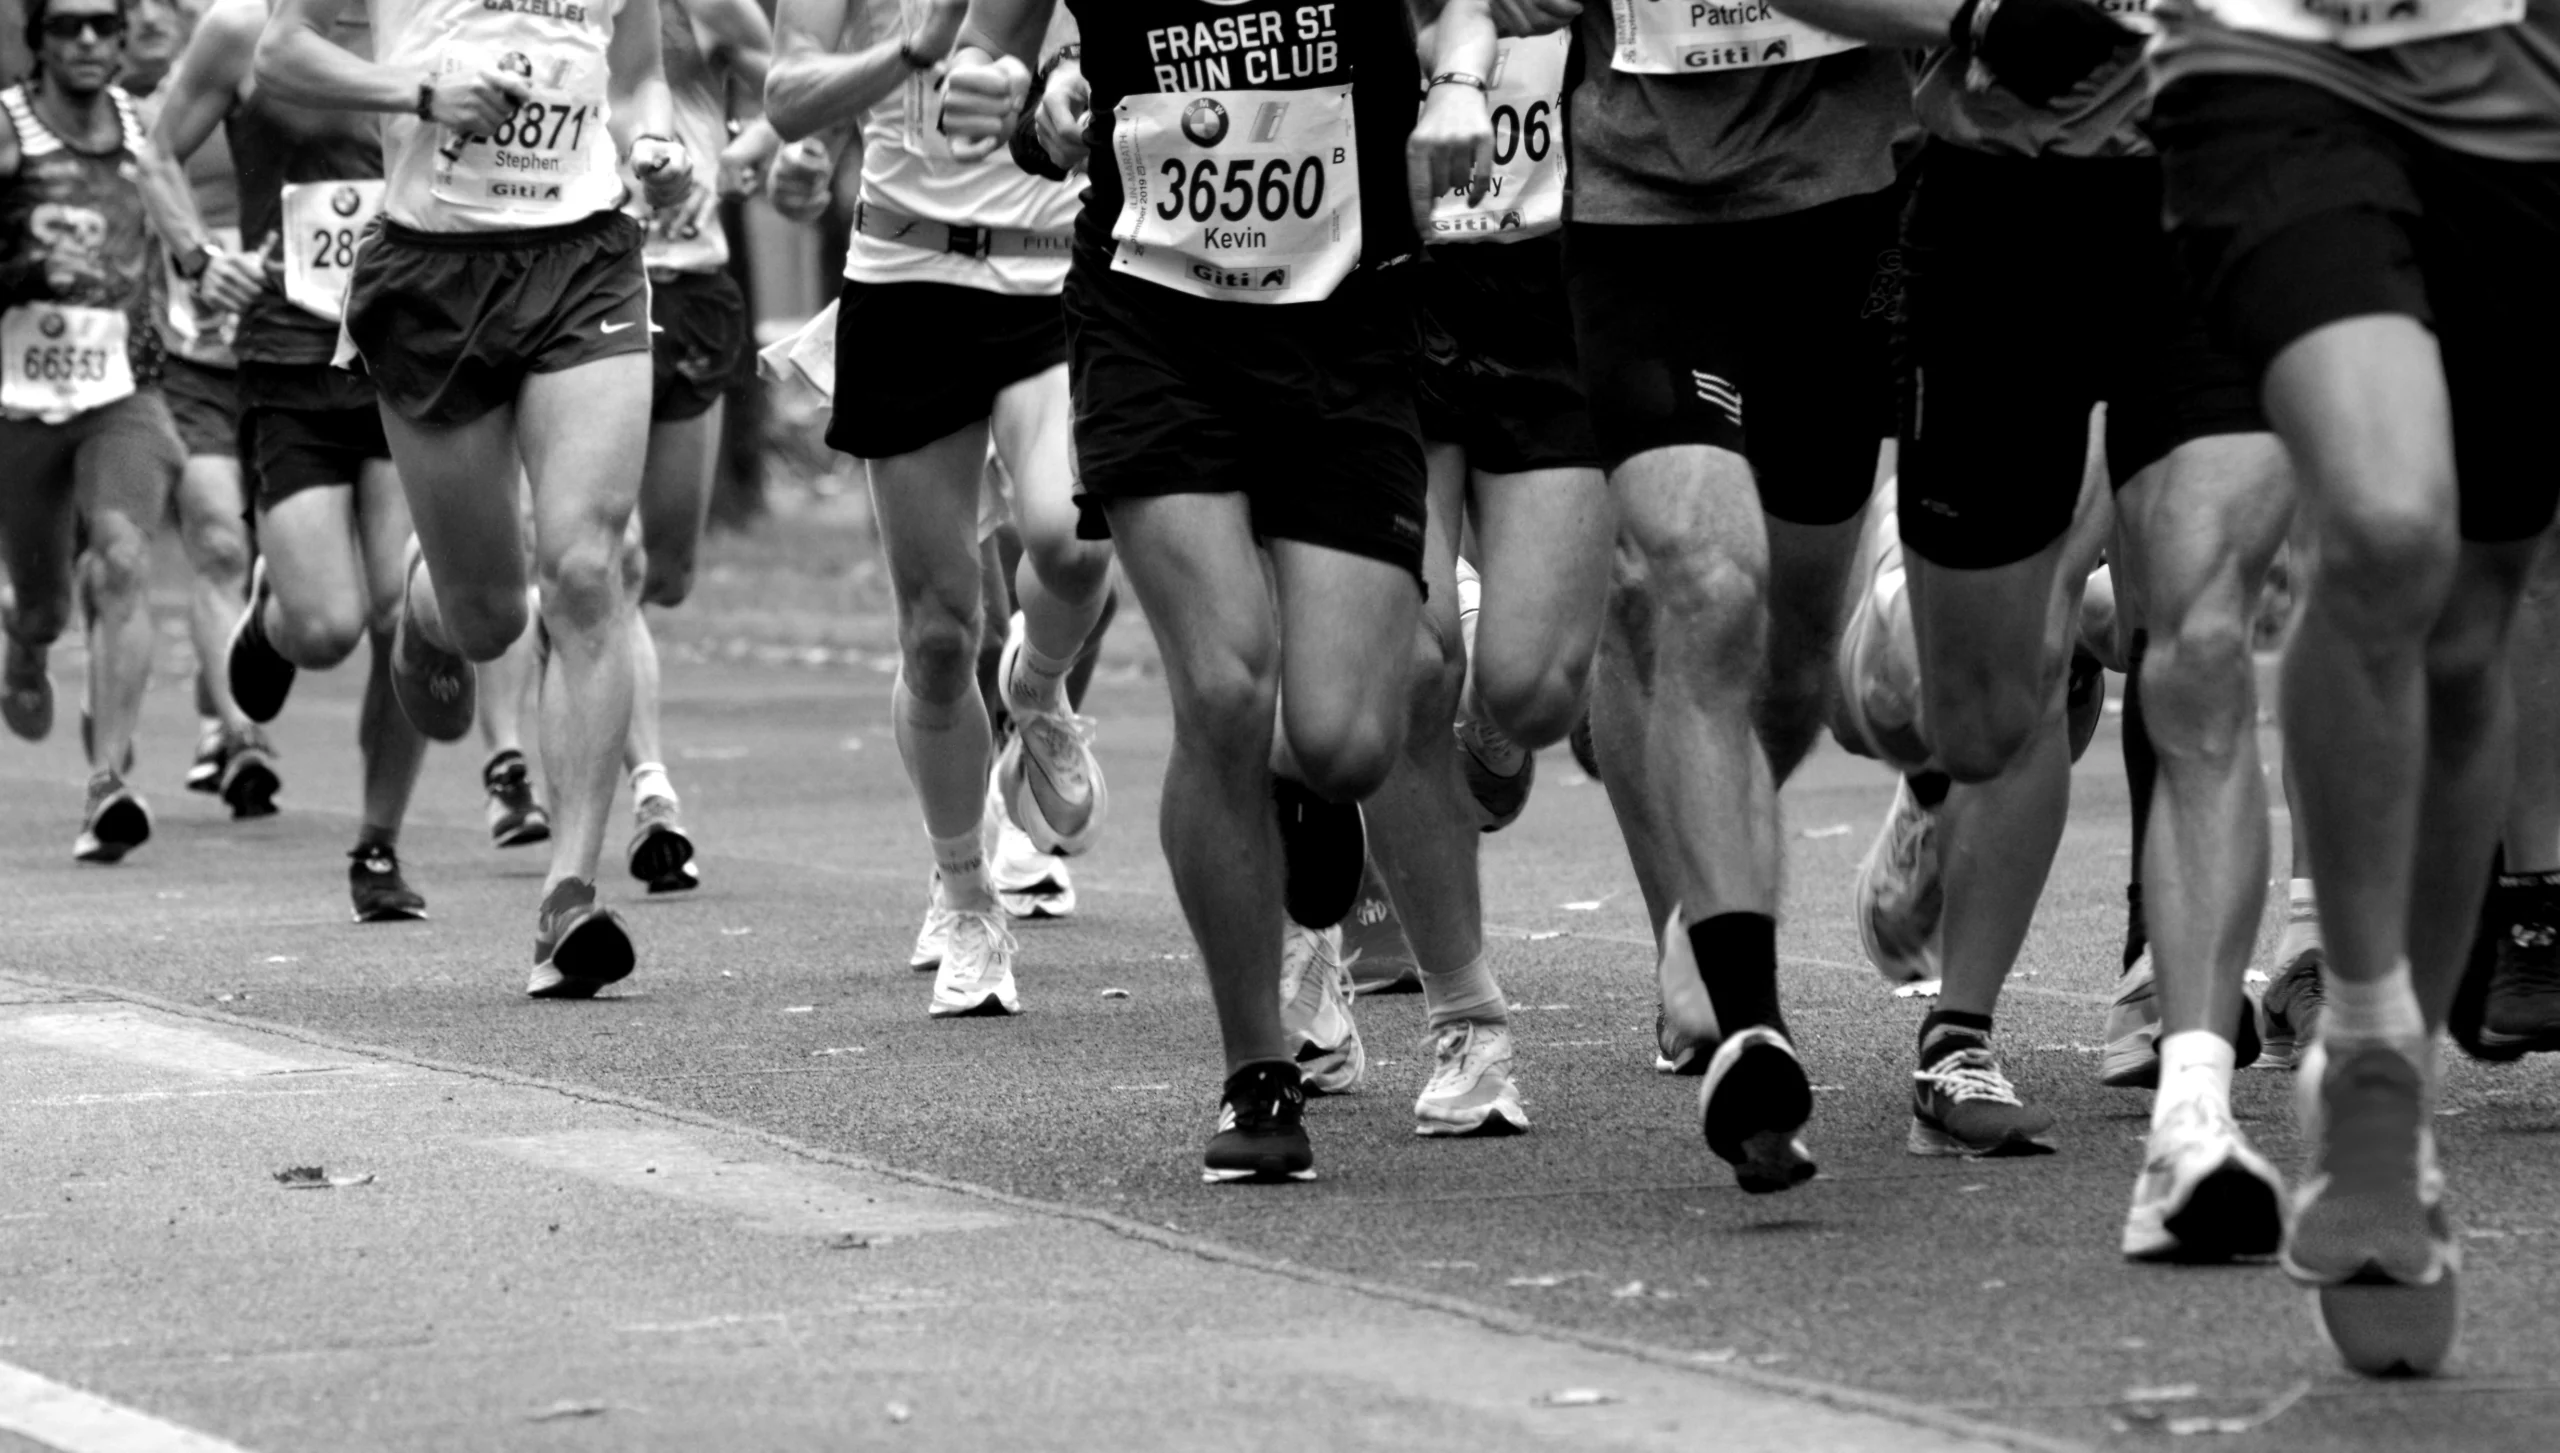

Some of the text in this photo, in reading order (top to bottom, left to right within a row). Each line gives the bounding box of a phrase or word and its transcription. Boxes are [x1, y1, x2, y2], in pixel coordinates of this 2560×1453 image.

[1690, 2, 1772, 28] Patrick
[1147, 3, 1336, 63] FRASER ST
[1154, 41, 1338, 93] RUN CLUB
[1685, 47, 1749, 68] Giti
[471, 102, 587, 151] 8871
[1491, 100, 1551, 166] 06
[495, 150, 560, 172] Stephen
[1332, 147, 1346, 164] B
[491, 183, 536, 198] Giti
[1138, 178, 1148, 205] 2019
[1157, 155, 1325, 223] 36560
[1435, 217, 1488, 231] Giti
[1204, 227, 1266, 249] Kevin
[1193, 264, 1250, 288] Giti
